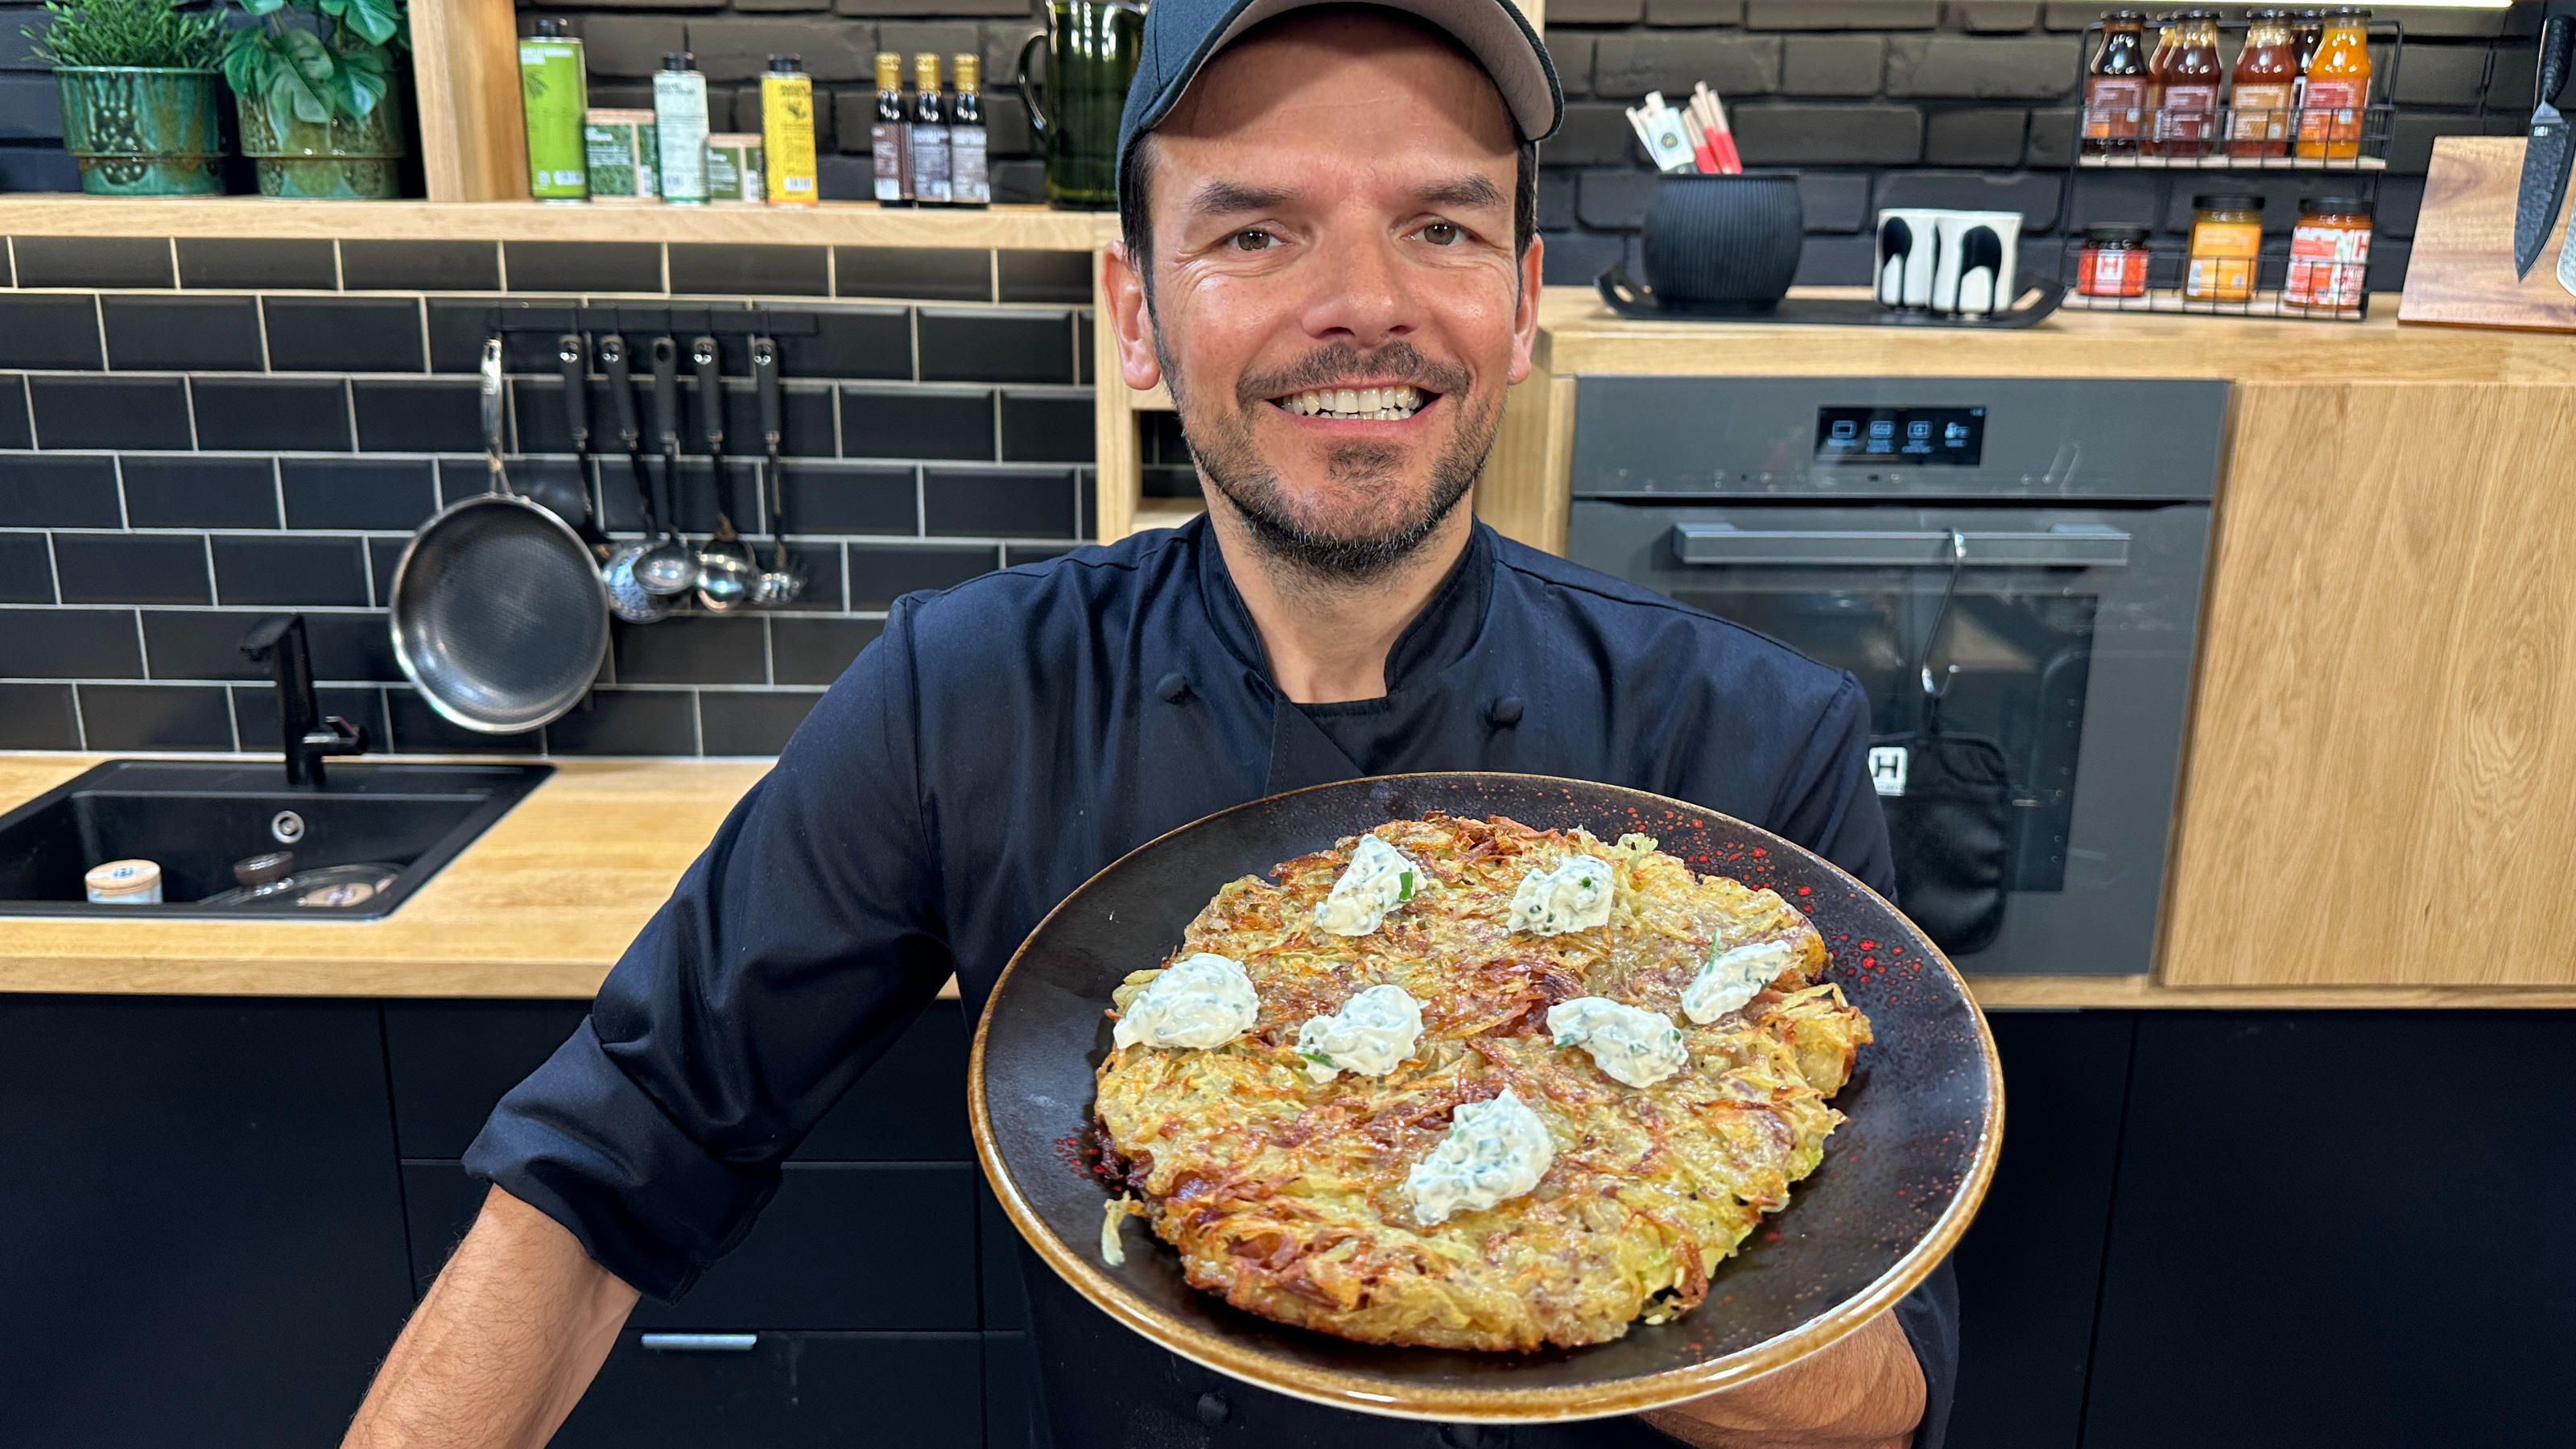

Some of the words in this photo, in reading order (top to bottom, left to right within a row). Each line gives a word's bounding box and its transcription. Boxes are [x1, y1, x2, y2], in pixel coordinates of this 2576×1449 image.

[2356, 235, 2368, 258] H
[2101, 256, 2119, 274] H
[1875, 753, 1898, 778] H
